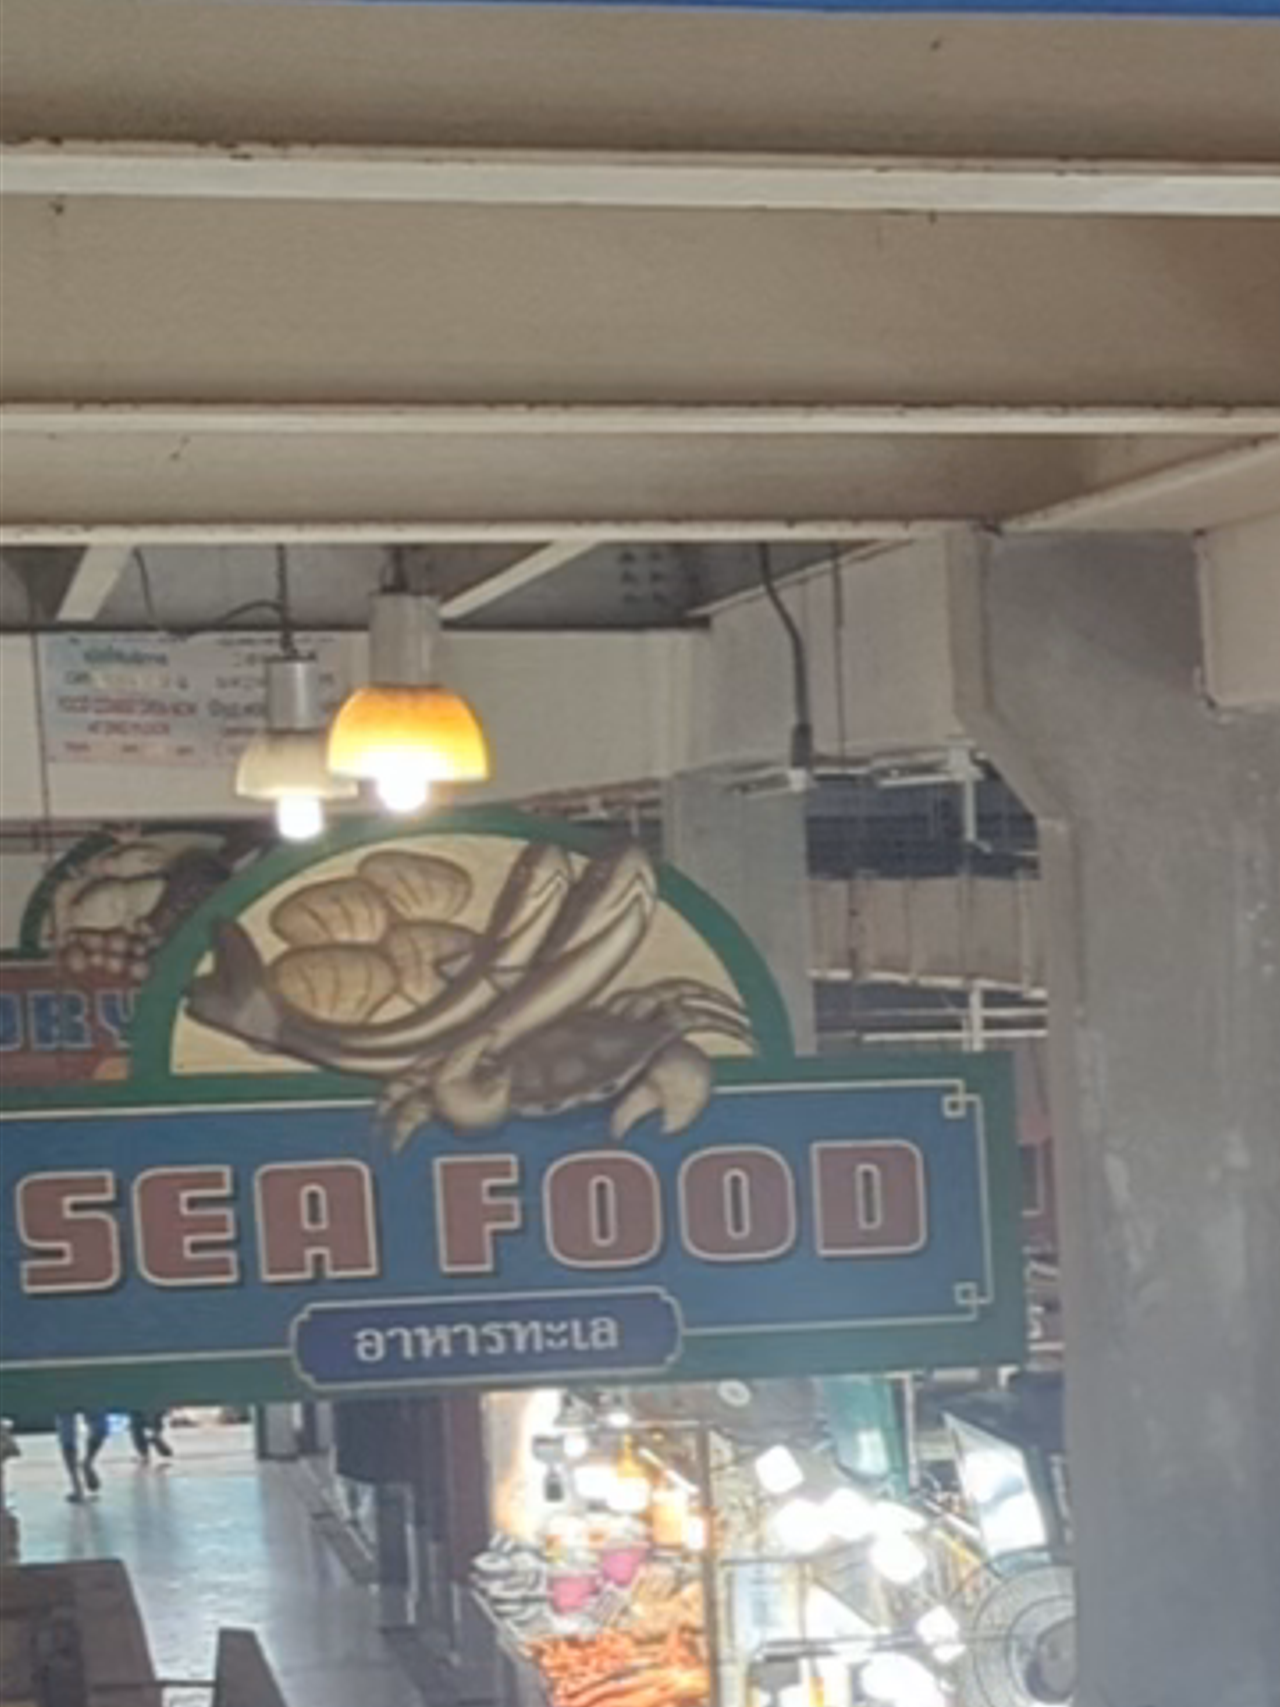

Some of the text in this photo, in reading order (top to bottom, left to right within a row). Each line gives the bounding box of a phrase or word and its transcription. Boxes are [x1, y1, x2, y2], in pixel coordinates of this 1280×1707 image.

[15, 1137, 928, 1292] SEA FOOD
[354, 1311, 620, 1363] อาหารทะเล
